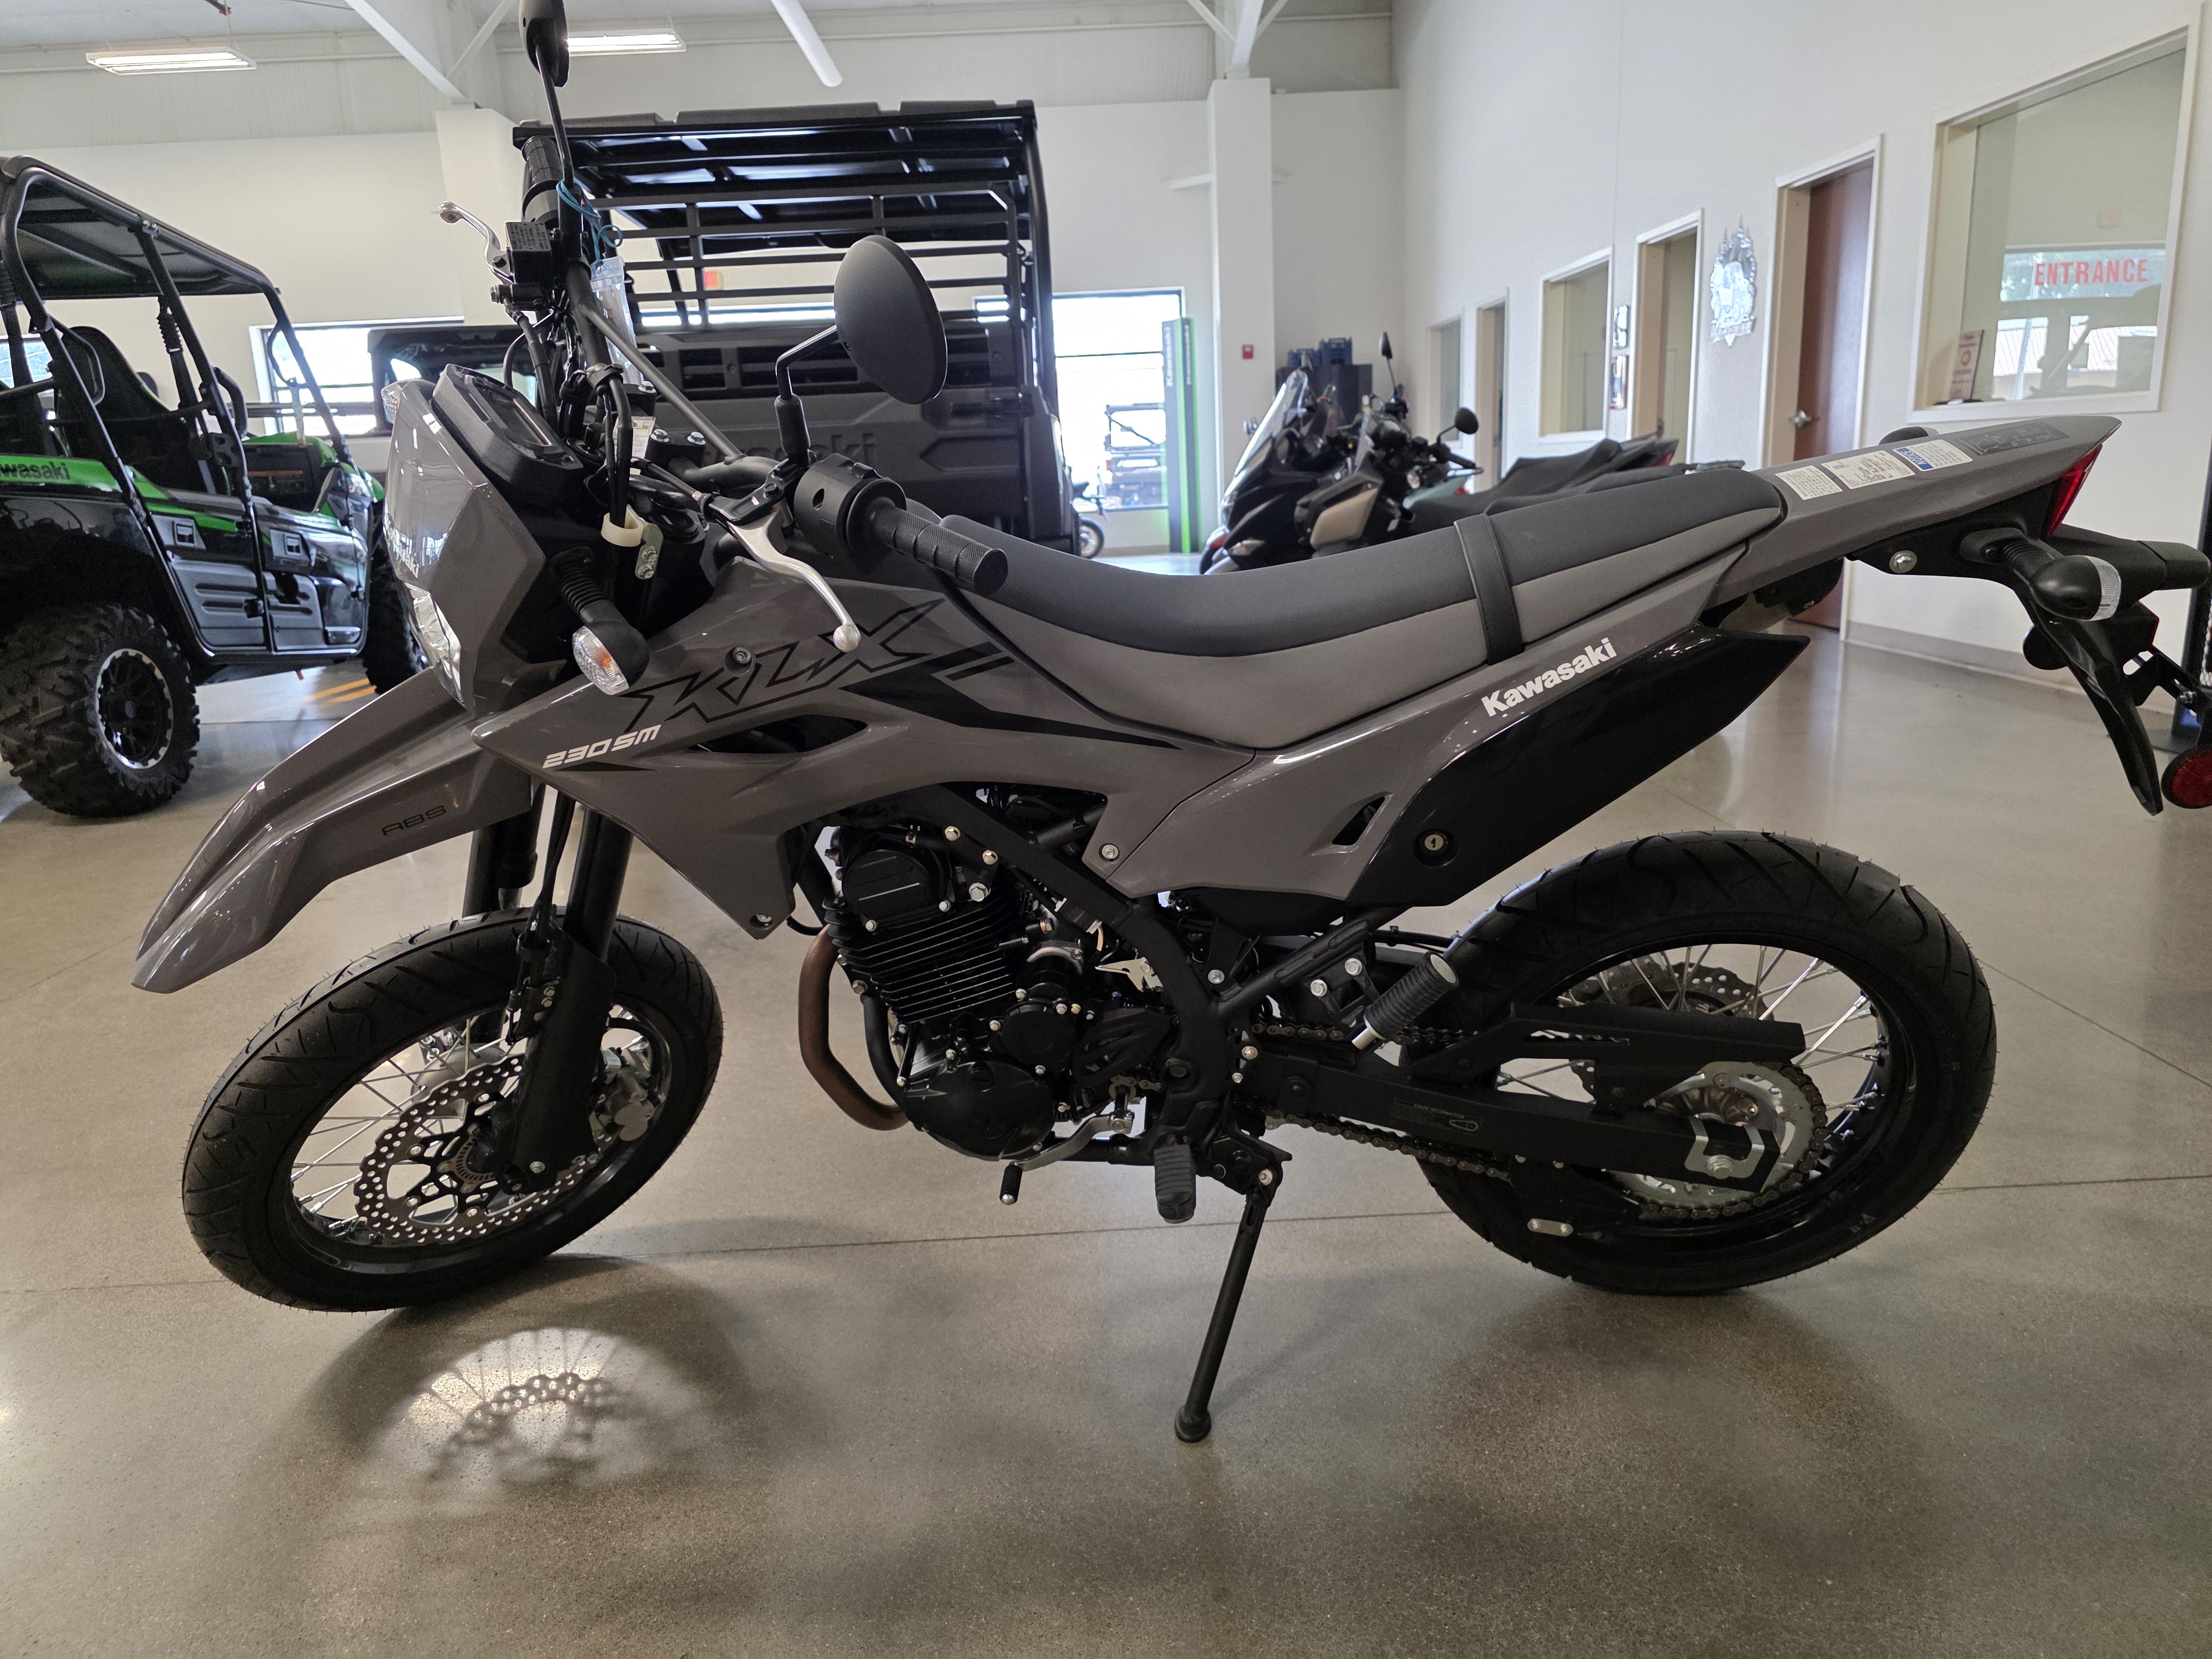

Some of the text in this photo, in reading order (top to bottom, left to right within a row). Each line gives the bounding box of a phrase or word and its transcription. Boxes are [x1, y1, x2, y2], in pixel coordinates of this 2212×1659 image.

[2034, 258, 2148, 286] ENTRANCE
[0, 461, 71, 480] wasaki
[1901, 450, 1928, 465] NOTICE
[619, 598, 945, 733] KLX
[1481, 637, 1617, 717] Kawasaki
[542, 724, 661, 769] 230SM
[381, 805, 447, 836] ABS
